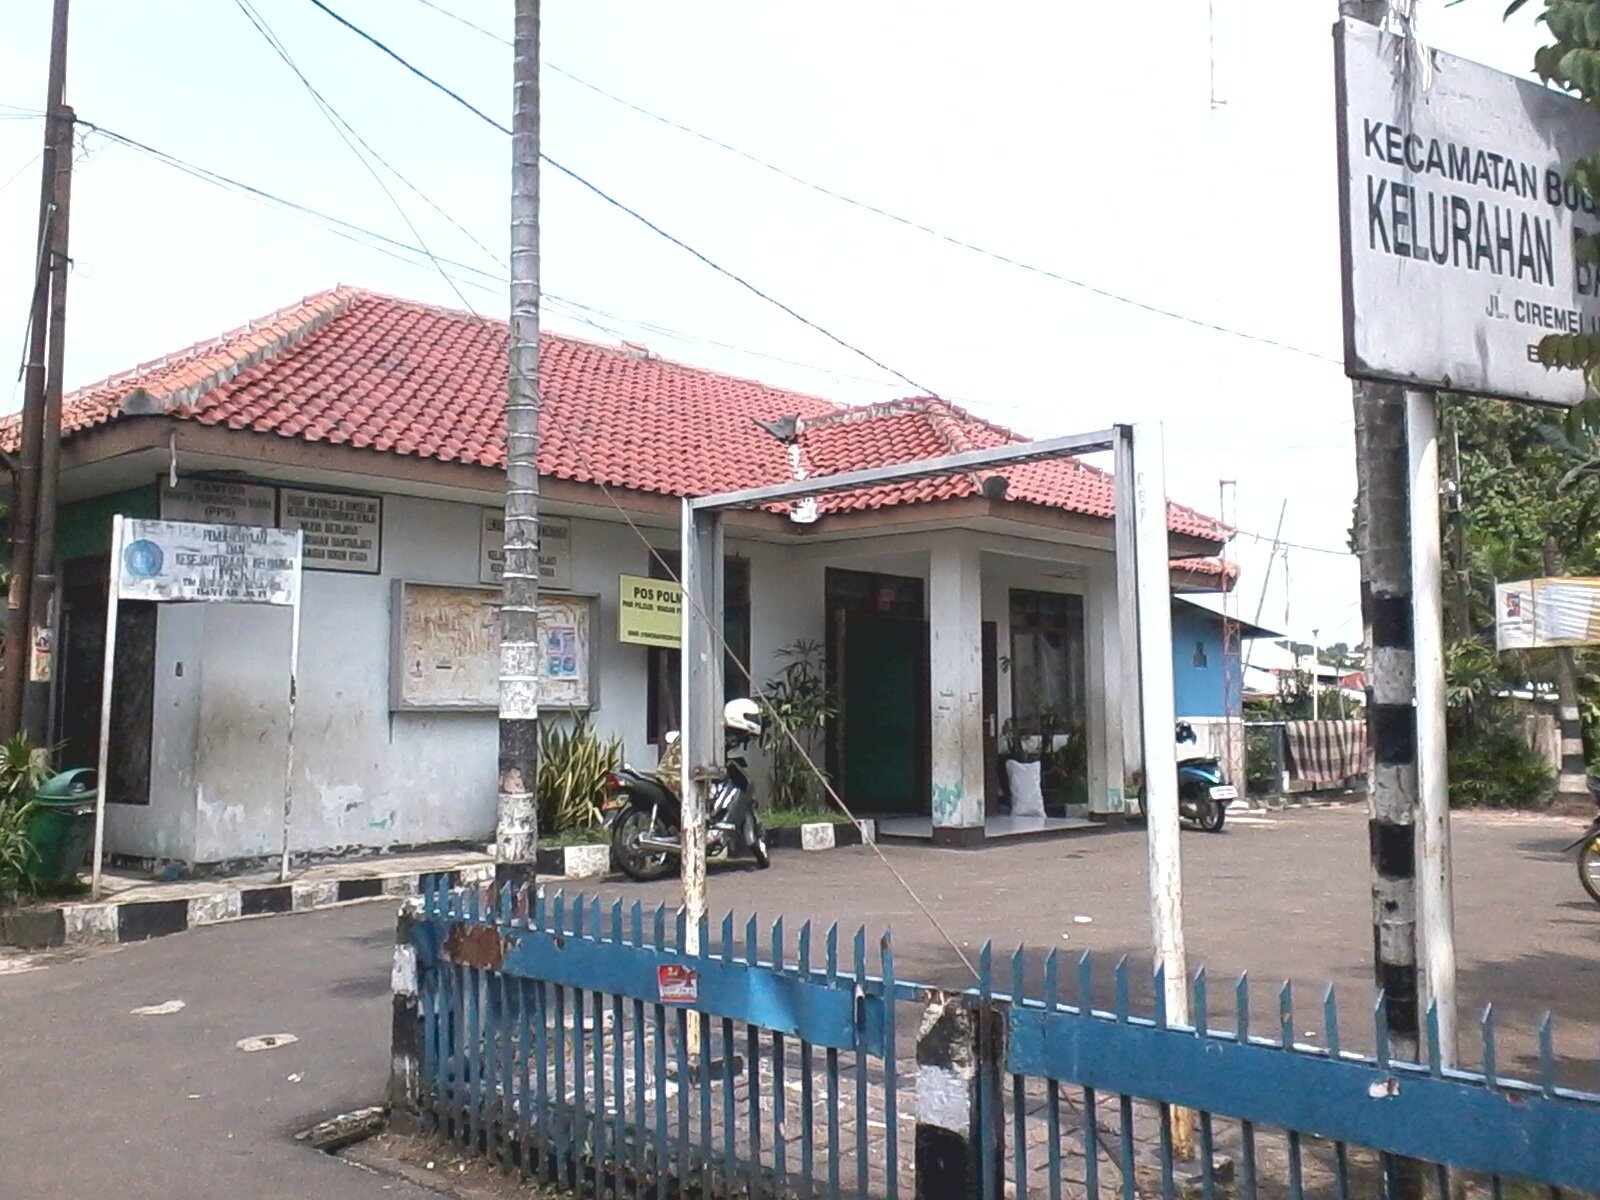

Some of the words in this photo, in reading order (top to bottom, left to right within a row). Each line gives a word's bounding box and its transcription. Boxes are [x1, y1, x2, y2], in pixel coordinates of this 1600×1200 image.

[1363, 117, 1538, 200] KECAMATAN
[1366, 173, 1556, 288] KELURAHAN
[1485, 293, 1509, 320] JL.
[1514, 298, 1583, 333] CIREMEI
[195, 482, 246, 495] KANTOR
[204, 506, 236, 519] (PPS)
[634, 587, 654, 601] POS
